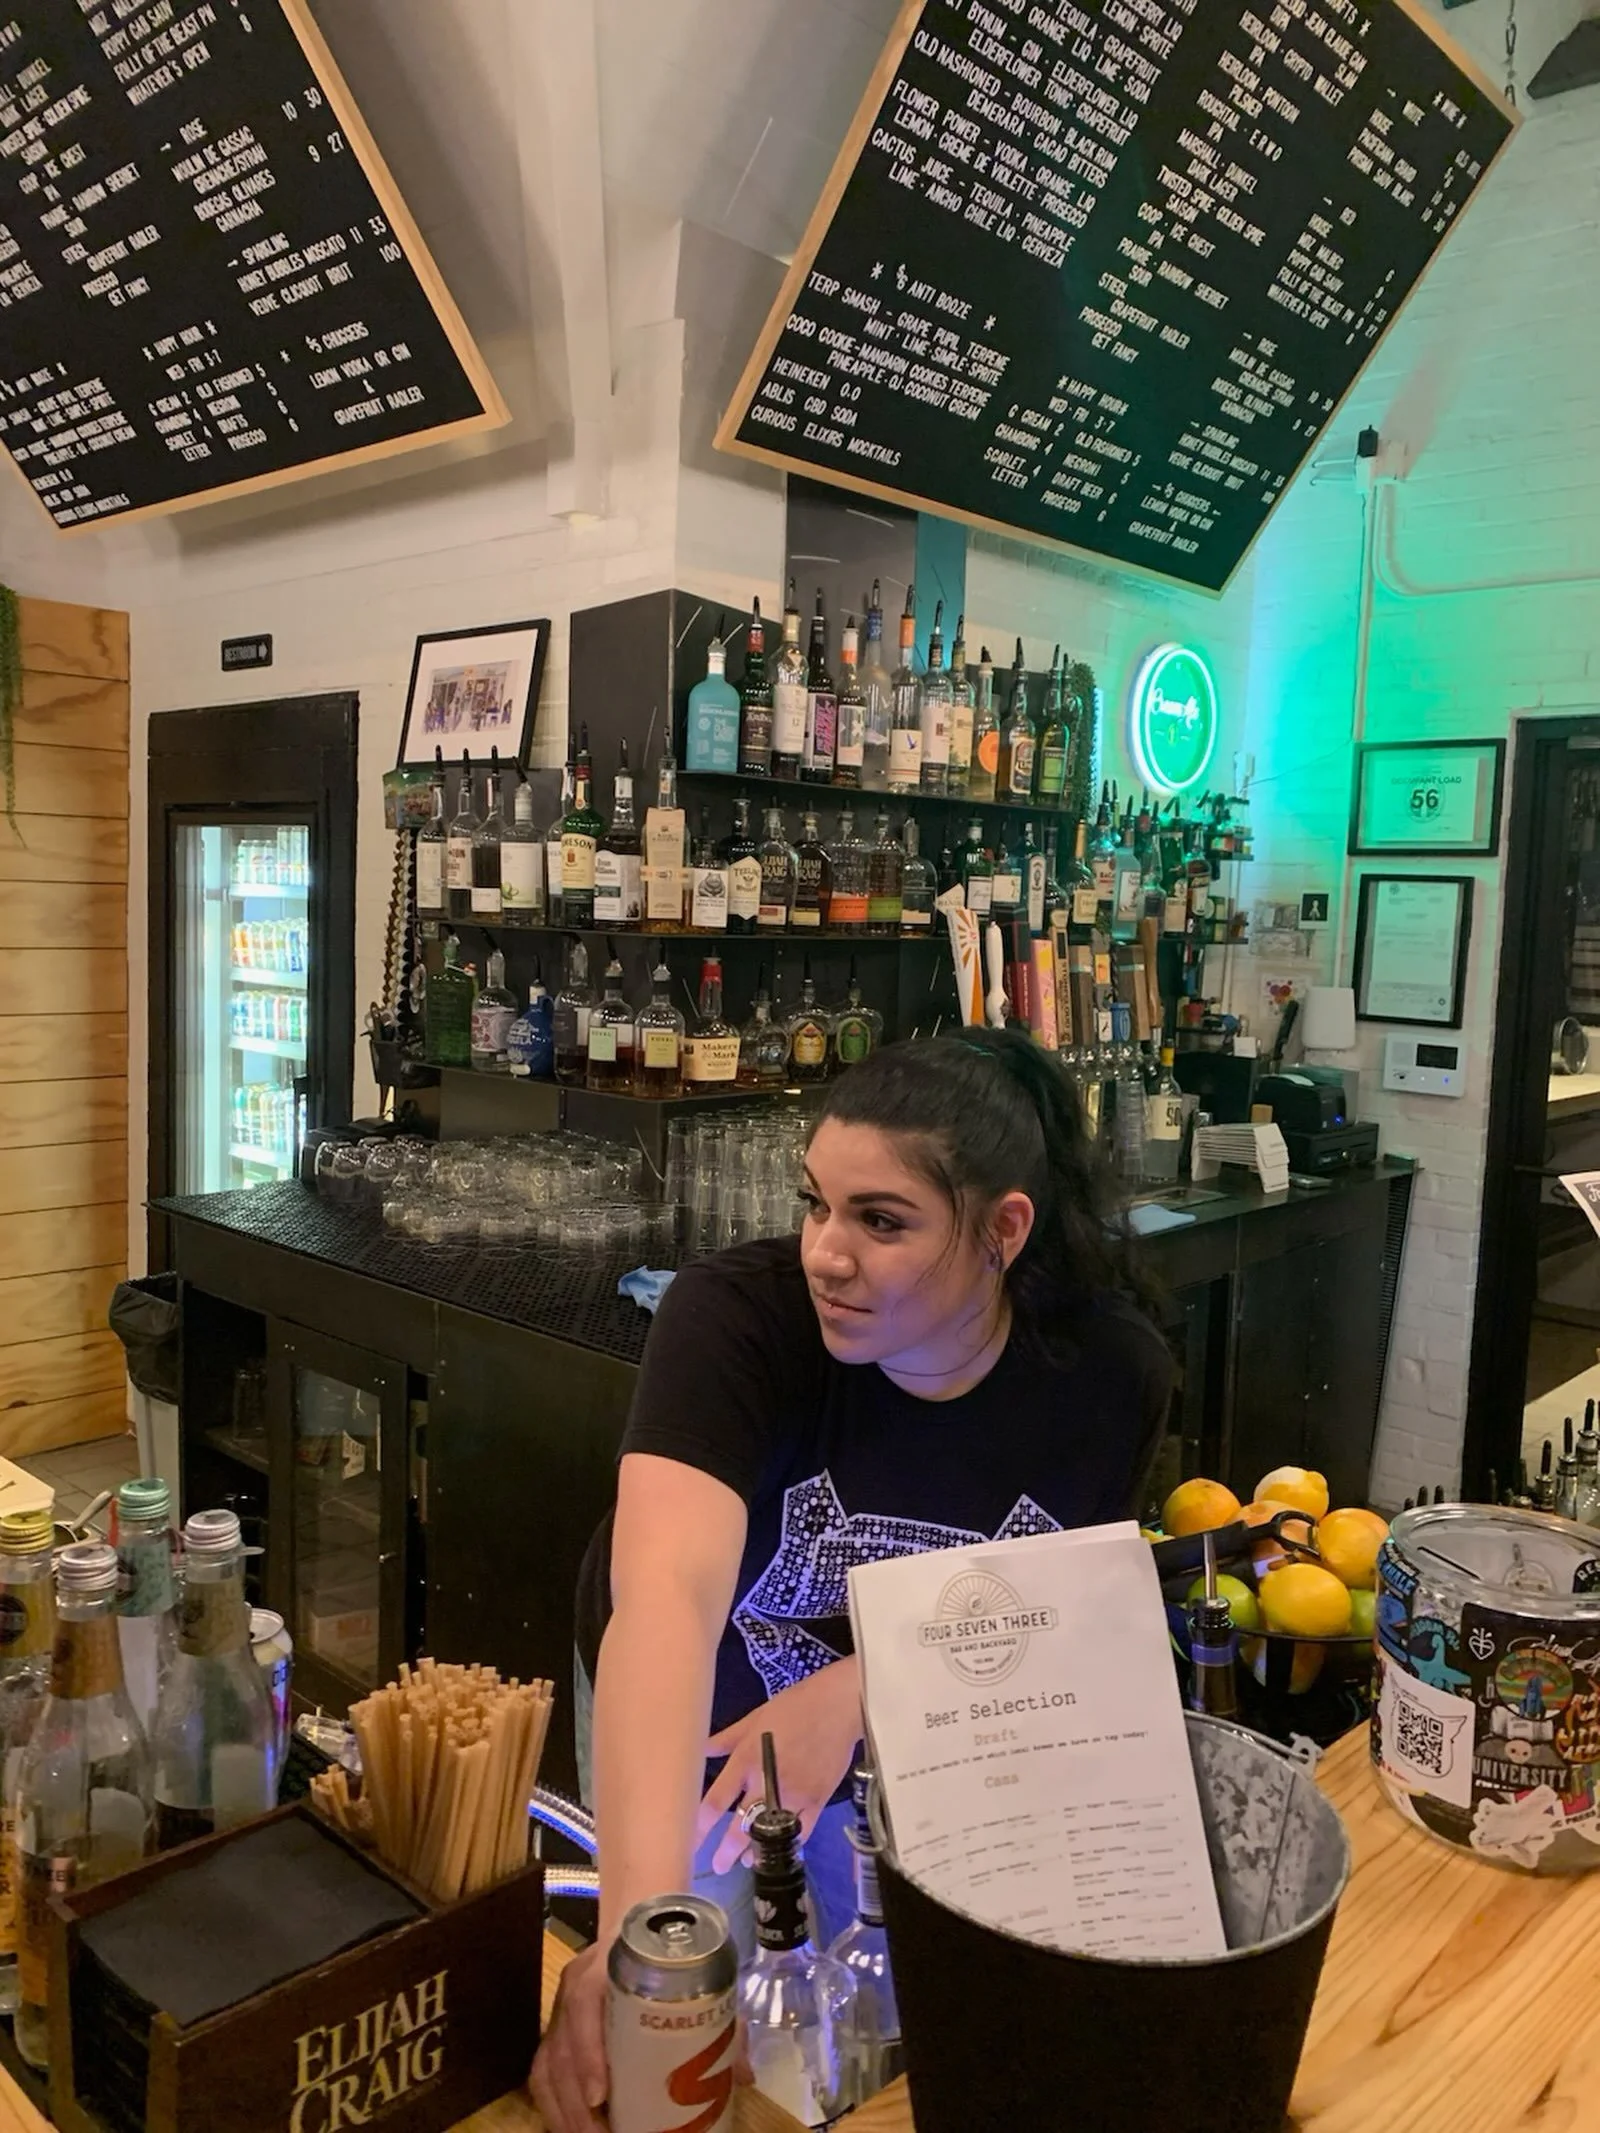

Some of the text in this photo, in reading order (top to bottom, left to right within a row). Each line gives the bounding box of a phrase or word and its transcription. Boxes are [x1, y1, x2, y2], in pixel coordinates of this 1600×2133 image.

[113, 12, 252, 83] FOLLY BEAST 8
[967, 0, 1007, 39] BYNUM
[1021, 39, 1042, 63] GIN
[1051, 60, 1119, 116] ELDERFLOWER
[1118, 106, 1138, 130] LIQ
[1028, 6, 1069, 45] ORANGE
[1071, 37, 1091, 62] LIQ
[1094, 54, 1121, 82] LIME
[1123, 75, 1150, 104] SODA
[1055, 0, 1097, 40] TEQUILA
[1103, 35, 1161, 84] GRAPEFRUIT
[1139, 25, 1175, 60] SPRITE
[126, 41, 210, 105] WHATEVER'S OPEN
[968, 28, 1130, 145] ELDERFLOWER TONIC GRAPEFRUIT
[914, 30, 1117, 171] OLD NASHIONED BOURBON BLACK RUM
[179, 117, 207, 144] ROSE
[202, 87, 321, 165] DE 10 30
[892, 79, 1095, 212] FLOWER POWER VODKA ORANGE LIQ
[966, 89, 1107, 188] DEMERARA CACAO BITTERS
[1177, 128, 1220, 169] MARSHALL
[232, 131, 344, 201] OLIVARES 9 27
[893, 105, 1087, 228] LEMON CREME DE VIOLETTE PROSECCO
[1157, 165, 1192, 197] TWISTED
[1186, 158, 1211, 183] DARK
[871, 128, 1075, 251] CACTUS JUICE TEQUILA PINEAPPLE
[888, 161, 1064, 268] LIME ANCHO CHILE LIQ CERVEZA
[1137, 202, 1188, 241] COOP ICE
[237, 215, 386, 292] HONEY BUBBLES MOSCATO 33
[242, 232, 289, 264] SPARKLING
[1147, 230, 1164, 249] IPA
[280, 242, 401, 303] CLICQUOT BRUT 100
[896, 263, 972, 319] $6 ANTI BOOZE
[1128, 264, 1152, 286] SOUR
[322, 321, 368, 349] CHUGGERS
[808, 271, 1010, 371] TERP SMASH GRAPE PUPIL TERPENE
[1078, 306, 1122, 336] PROSECCO
[1092, 331, 1111, 349] GET
[1110, 299, 1190, 349] GRAPEFRUIT RADLER
[255, 363, 266, 377] 5
[309, 342, 411, 388] LEMON VODKA OR GIN
[786, 312, 816, 336] COCO
[909, 364, 948, 390] COOKIES
[948, 379, 991, 406] TERPENE
[863, 317, 1002, 386] MINT LIME SIMPLE SPRITE
[266, 381, 277, 395] 5
[772, 357, 861, 401] HEINEKEN 0.0
[827, 350, 981, 420] PINEAPPLE COCONUT CREAM
[1066, 379, 1097, 401] HAPPY
[334, 386, 424, 424] GRAPEFRUIT RADLER
[761, 381, 857, 426] ABLIS CBD SODA
[1072, 406, 1089, 422] FRI
[751, 405, 900, 465] CURIOUS ELIXIRS MOCKTAILS
[1008, 404, 1141, 466] G CREAM 2 OLD 5
[983, 446, 1117, 504] SCARLET 4 DRAFT BEER 6
[1044, 442, 1053, 455] 4
[1120, 472, 1130, 484] 5
[991, 466, 1106, 521] LETTER PROSECCO 6
[1410, 788, 1439, 809] 56
[1438, 775, 1462, 785] LOAD
[924, 1611, 1049, 1641] FOUR SEVEN THREE
[964, 1643, 979, 1652] AND
[980, 1638, 1018, 1650] BACKYARD
[924, 1690, 1078, 1730] Beer Selection
[973, 1728, 1019, 1747] Draft
[1473, 1756, 1569, 1789] UNIVERSITY
[291, 1969, 450, 2095] ELIJAH
[639, 2007, 716, 2031] SCARLET
[288, 2026, 446, 2133] CRAIG
